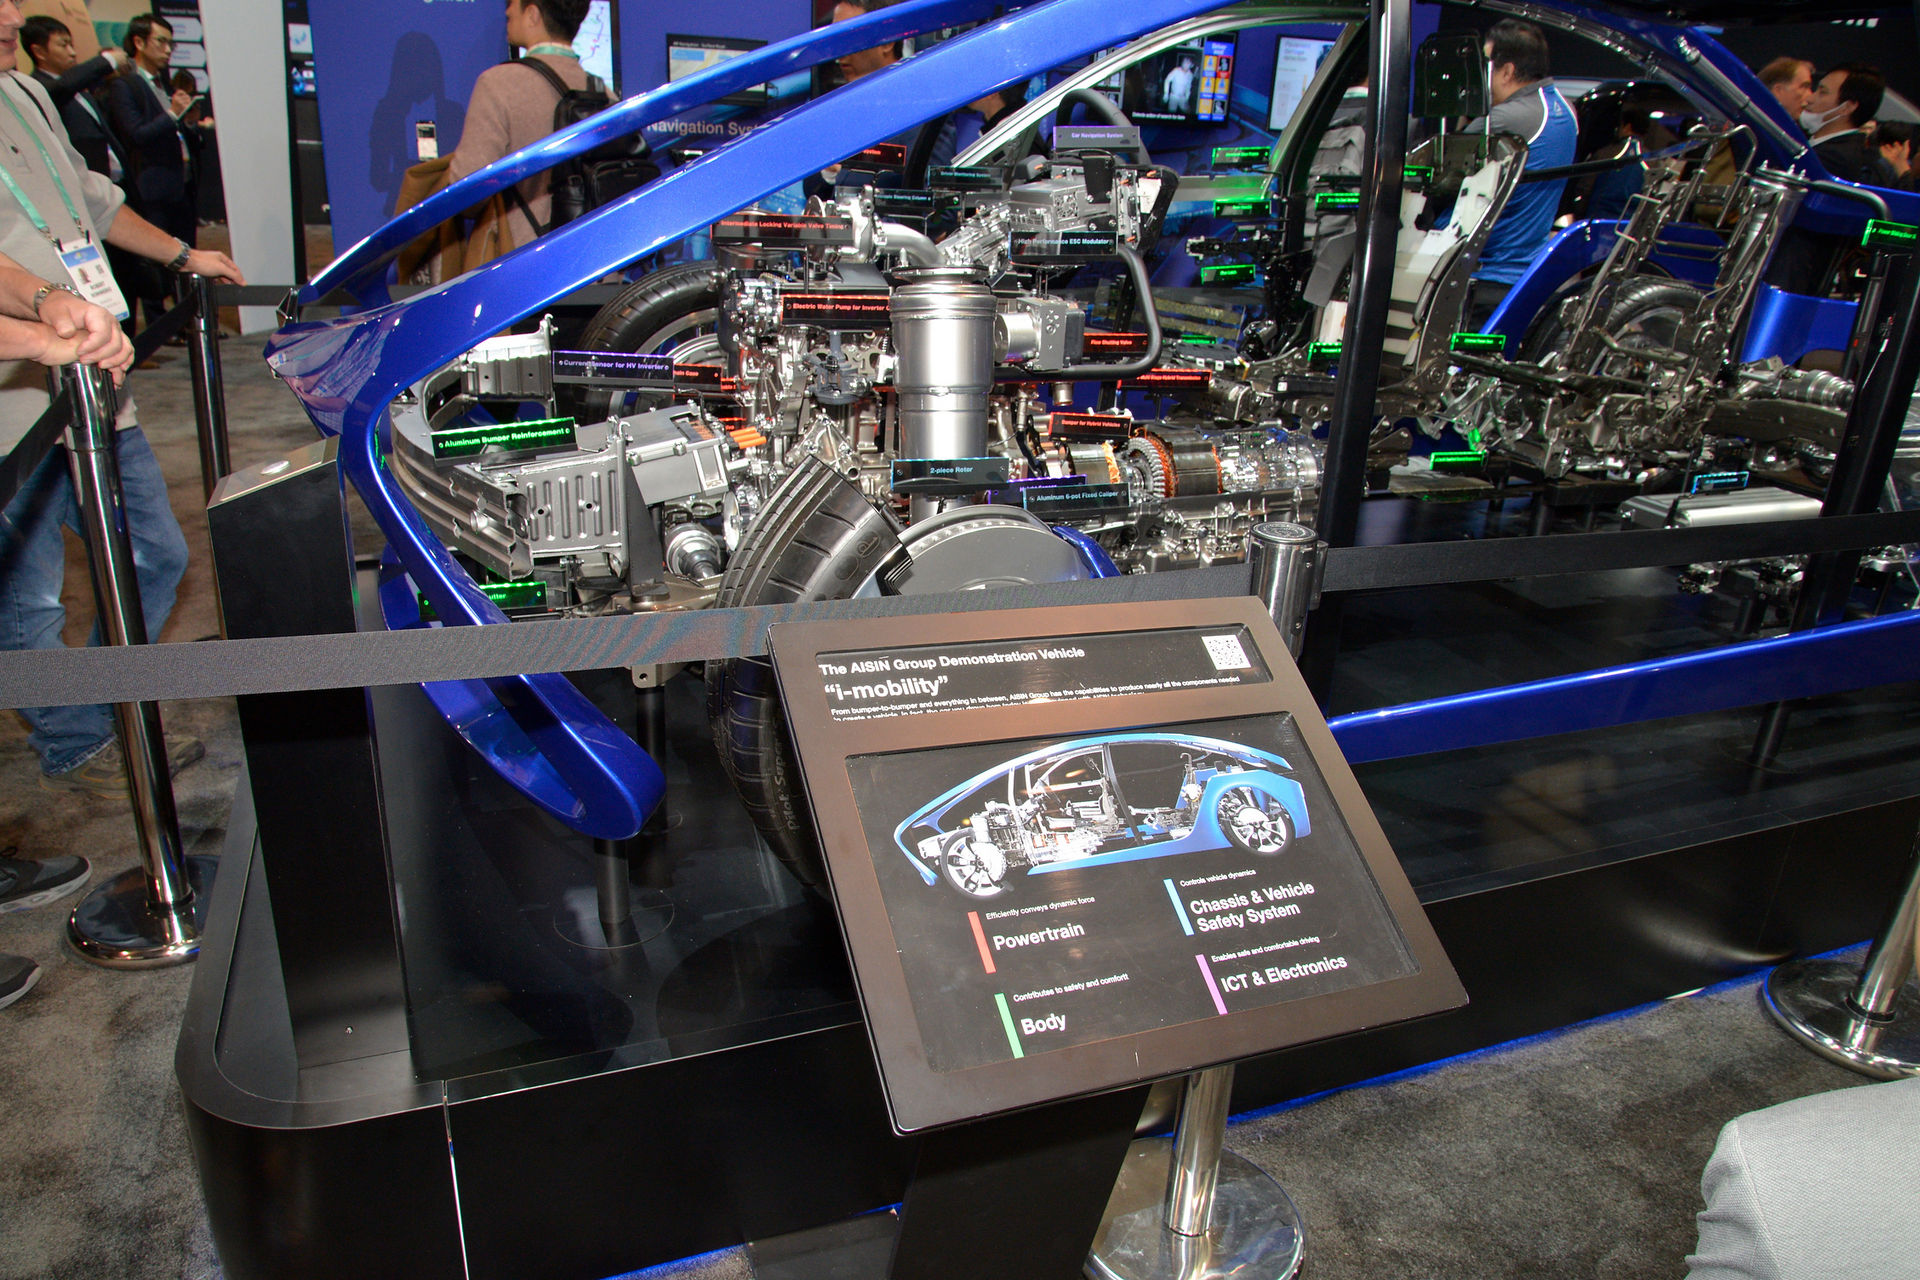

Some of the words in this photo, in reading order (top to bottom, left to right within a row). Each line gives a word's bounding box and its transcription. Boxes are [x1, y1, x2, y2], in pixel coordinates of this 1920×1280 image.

[638, 362, 664, 370] Inverter
[444, 436, 480, 447] Aluminum
[482, 432, 510, 444] Bumper
[511, 428, 564, 440] Reinforcement
[930, 466, 954, 474] 2-piece
[1036, 493, 1064, 502] Aluminum
[1066, 492, 1081, 500] 6-pot
[1082, 492, 1098, 500] Fixed
[1098, 490, 1118, 500] Caliper
[818, 663, 848, 676] The
[851, 656, 890, 674] AISIN
[893, 658, 937, 670] Group
[938, 650, 1038, 667] Demonstration
[1038, 647, 1086, 660] Vehicle
[851, 703, 918, 714] bumper-to-bumper
[934, 698, 970, 707] everything
[1010, 692, 1028, 700] AISIN
[1028, 691, 1050, 700] Group
[1074, 686, 1110, 696] capabilities
[1118, 684, 1144, 692] produce
[1144, 682, 1162, 690] nearly
[1182, 678, 1218, 686] components
[1180, 876, 1206, 888] Controls
[1206, 873, 1228, 882] vehicle
[1228, 868, 1256, 879] dynamics
[986, 908, 1020, 920] Efficiently
[1020, 904, 1048, 914] conveys
[1049, 899, 1077, 910] dynamic
[1078, 896, 1096, 904] force
[1190, 893, 1250, 915] Chassis
[1250, 890, 1264, 904] &
[1262, 882, 1315, 900] Vehicle
[1196, 912, 1244, 932] Safety
[1246, 903, 1300, 924] System
[992, 922, 1086, 950] Powertrain
[1211, 952, 1236, 963] Enables
[1236, 948, 1250, 958] safe
[1251, 946, 1263, 955] and
[1264, 940, 1300, 953] comfortable
[1300, 936, 1320, 946] driving
[1220, 973, 1250, 993] ICT
[1252, 970, 1266, 986] &
[1264, 956, 1348, 983] Electronics
[1013, 986, 1054, 1002] Contributes
[1064, 982, 1085, 993] safety
[1086, 978, 1100, 988] and
[1020, 1012, 1066, 1036] Body
